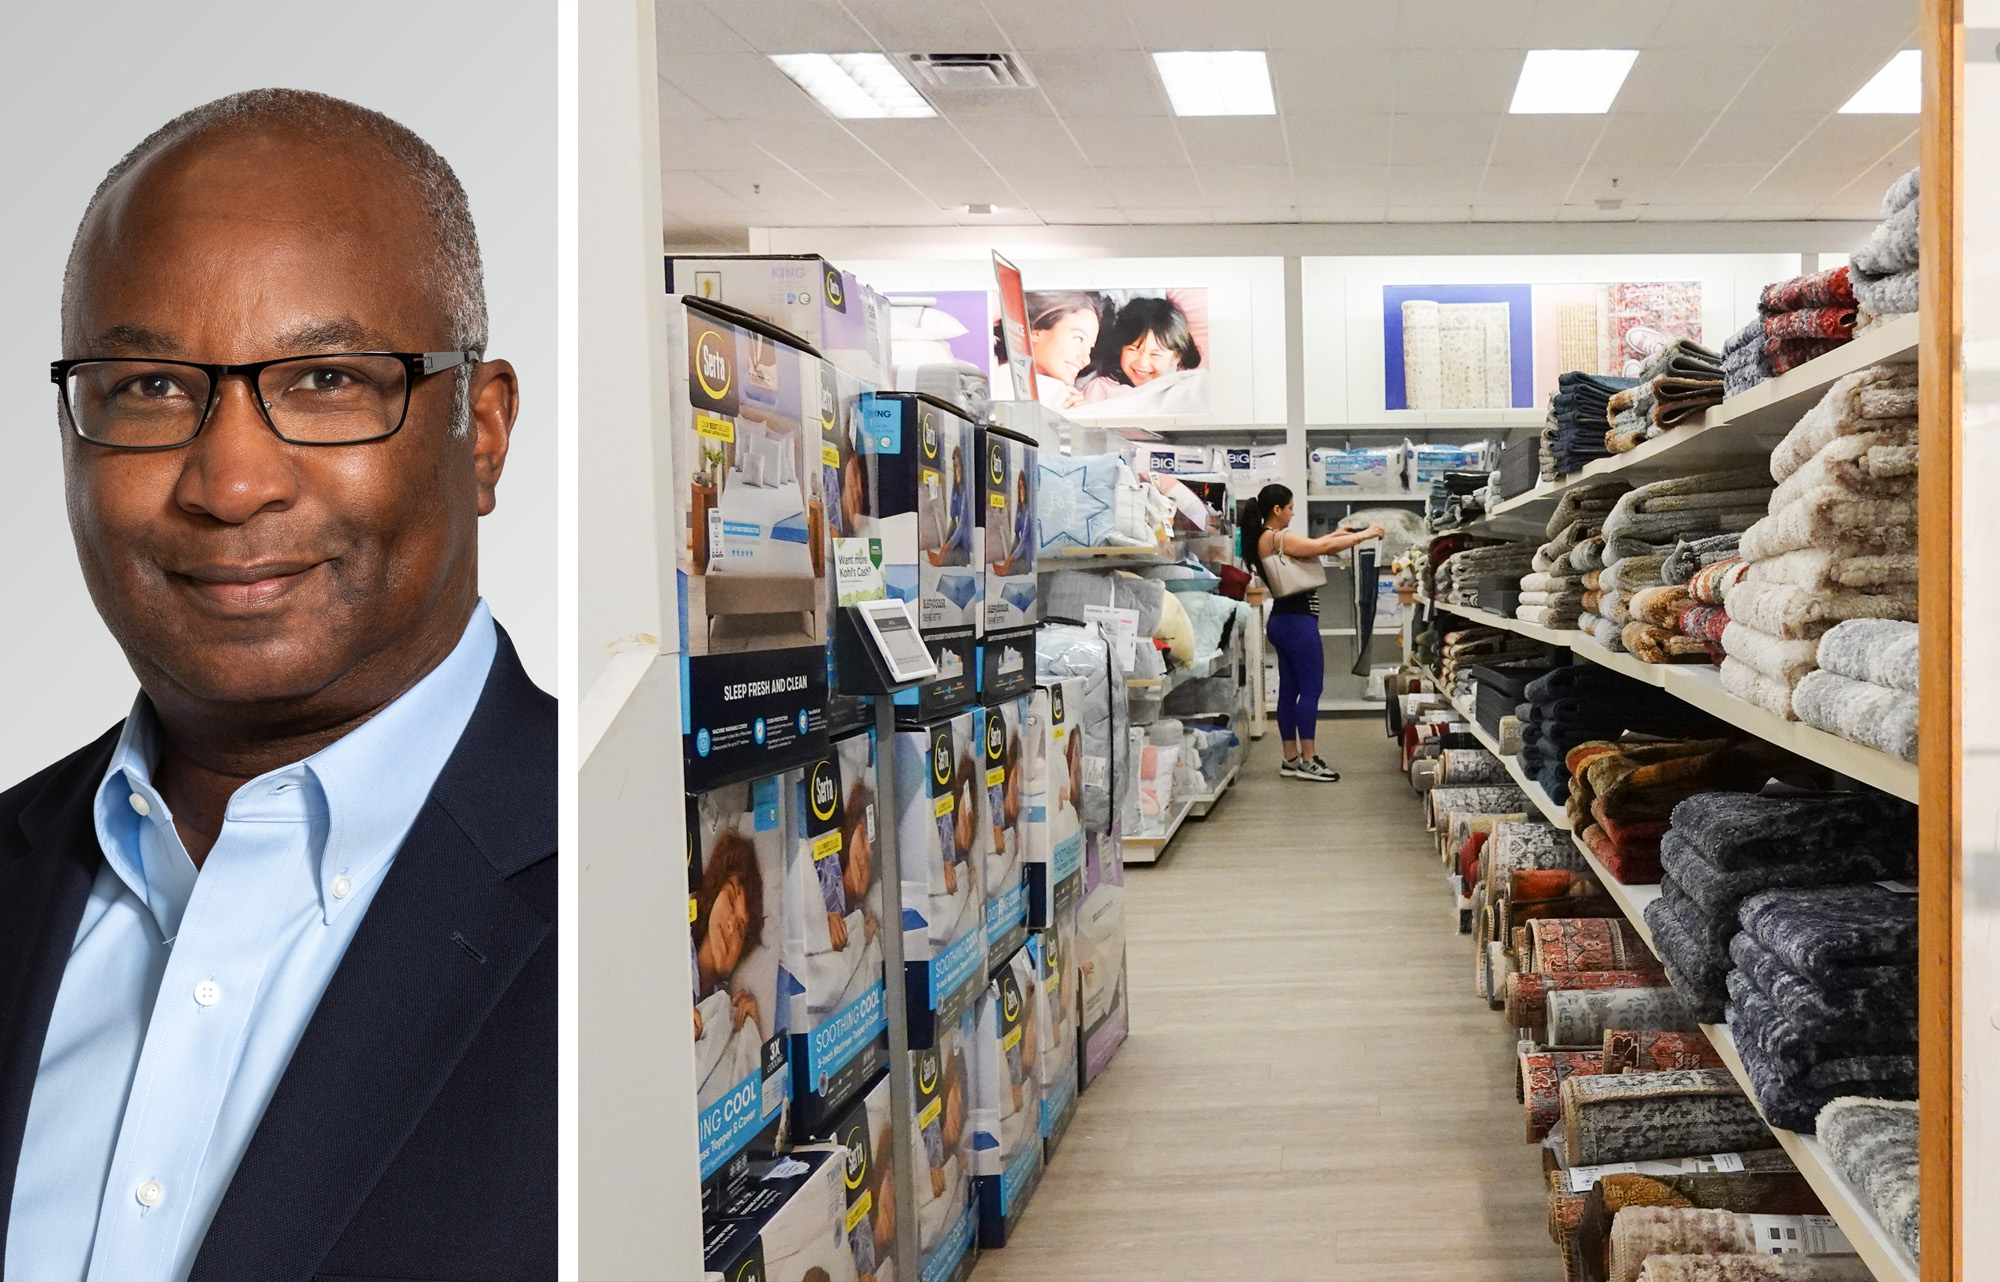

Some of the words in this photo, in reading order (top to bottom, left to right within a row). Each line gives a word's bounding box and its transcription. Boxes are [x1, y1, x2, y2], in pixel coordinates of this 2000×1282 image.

[771, 267, 806, 279] KING
[703, 344, 726, 382] Serta
[1151, 458, 1175, 469] BIG
[838, 555, 854, 566] Want
[854, 556, 868, 565] more
[840, 566, 857, 578] Kohl's
[857, 567, 873, 577] Cash?
[724, 682, 748, 701] SLEEP
[748, 679, 771, 697] FRESH
[771, 677, 786, 694] AND
[786, 674, 808, 692] CLEAN
[816, 776, 834, 805] Serta
[816, 1006, 860, 1053] SOOTHING
[860, 988, 880, 1018] COOL
[769, 1038, 781, 1061] 3X
[766, 1054, 784, 1073] COOLING
[699, 1109, 722, 1143] ING
[723, 1081, 757, 1122] COOL
[710, 1128, 733, 1152] Topper
[738, 1108, 757, 1130] Cover
